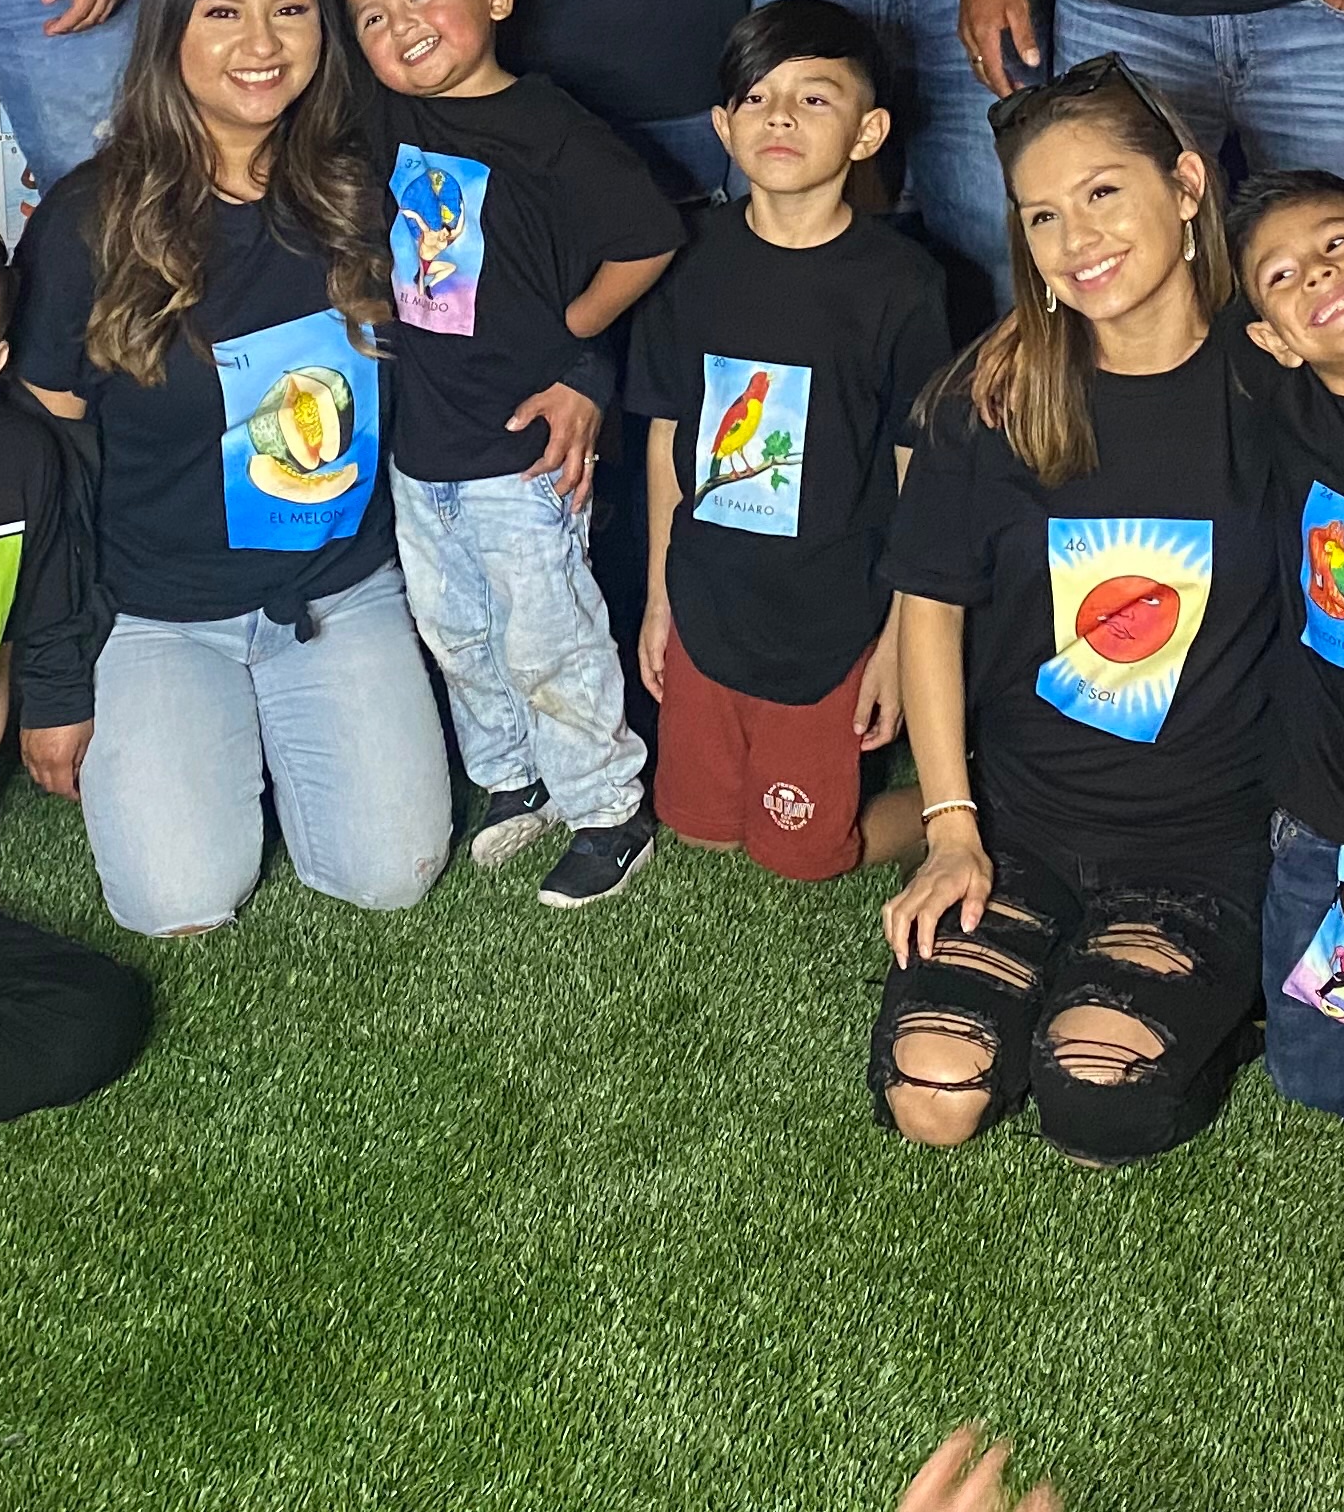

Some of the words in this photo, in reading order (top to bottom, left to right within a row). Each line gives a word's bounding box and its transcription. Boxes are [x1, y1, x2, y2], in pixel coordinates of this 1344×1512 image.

[404, 157, 422, 170] 37
[234, 353, 250, 370] 11
[713, 356, 726, 368] 20
[1319, 486, 1334, 502] 24
[714, 495, 724, 507] EL
[728, 500, 775, 516] PAJARO
[270, 512, 286, 524] EL
[290, 507, 346, 525] MELON
[1064, 537, 1087, 552] 46
